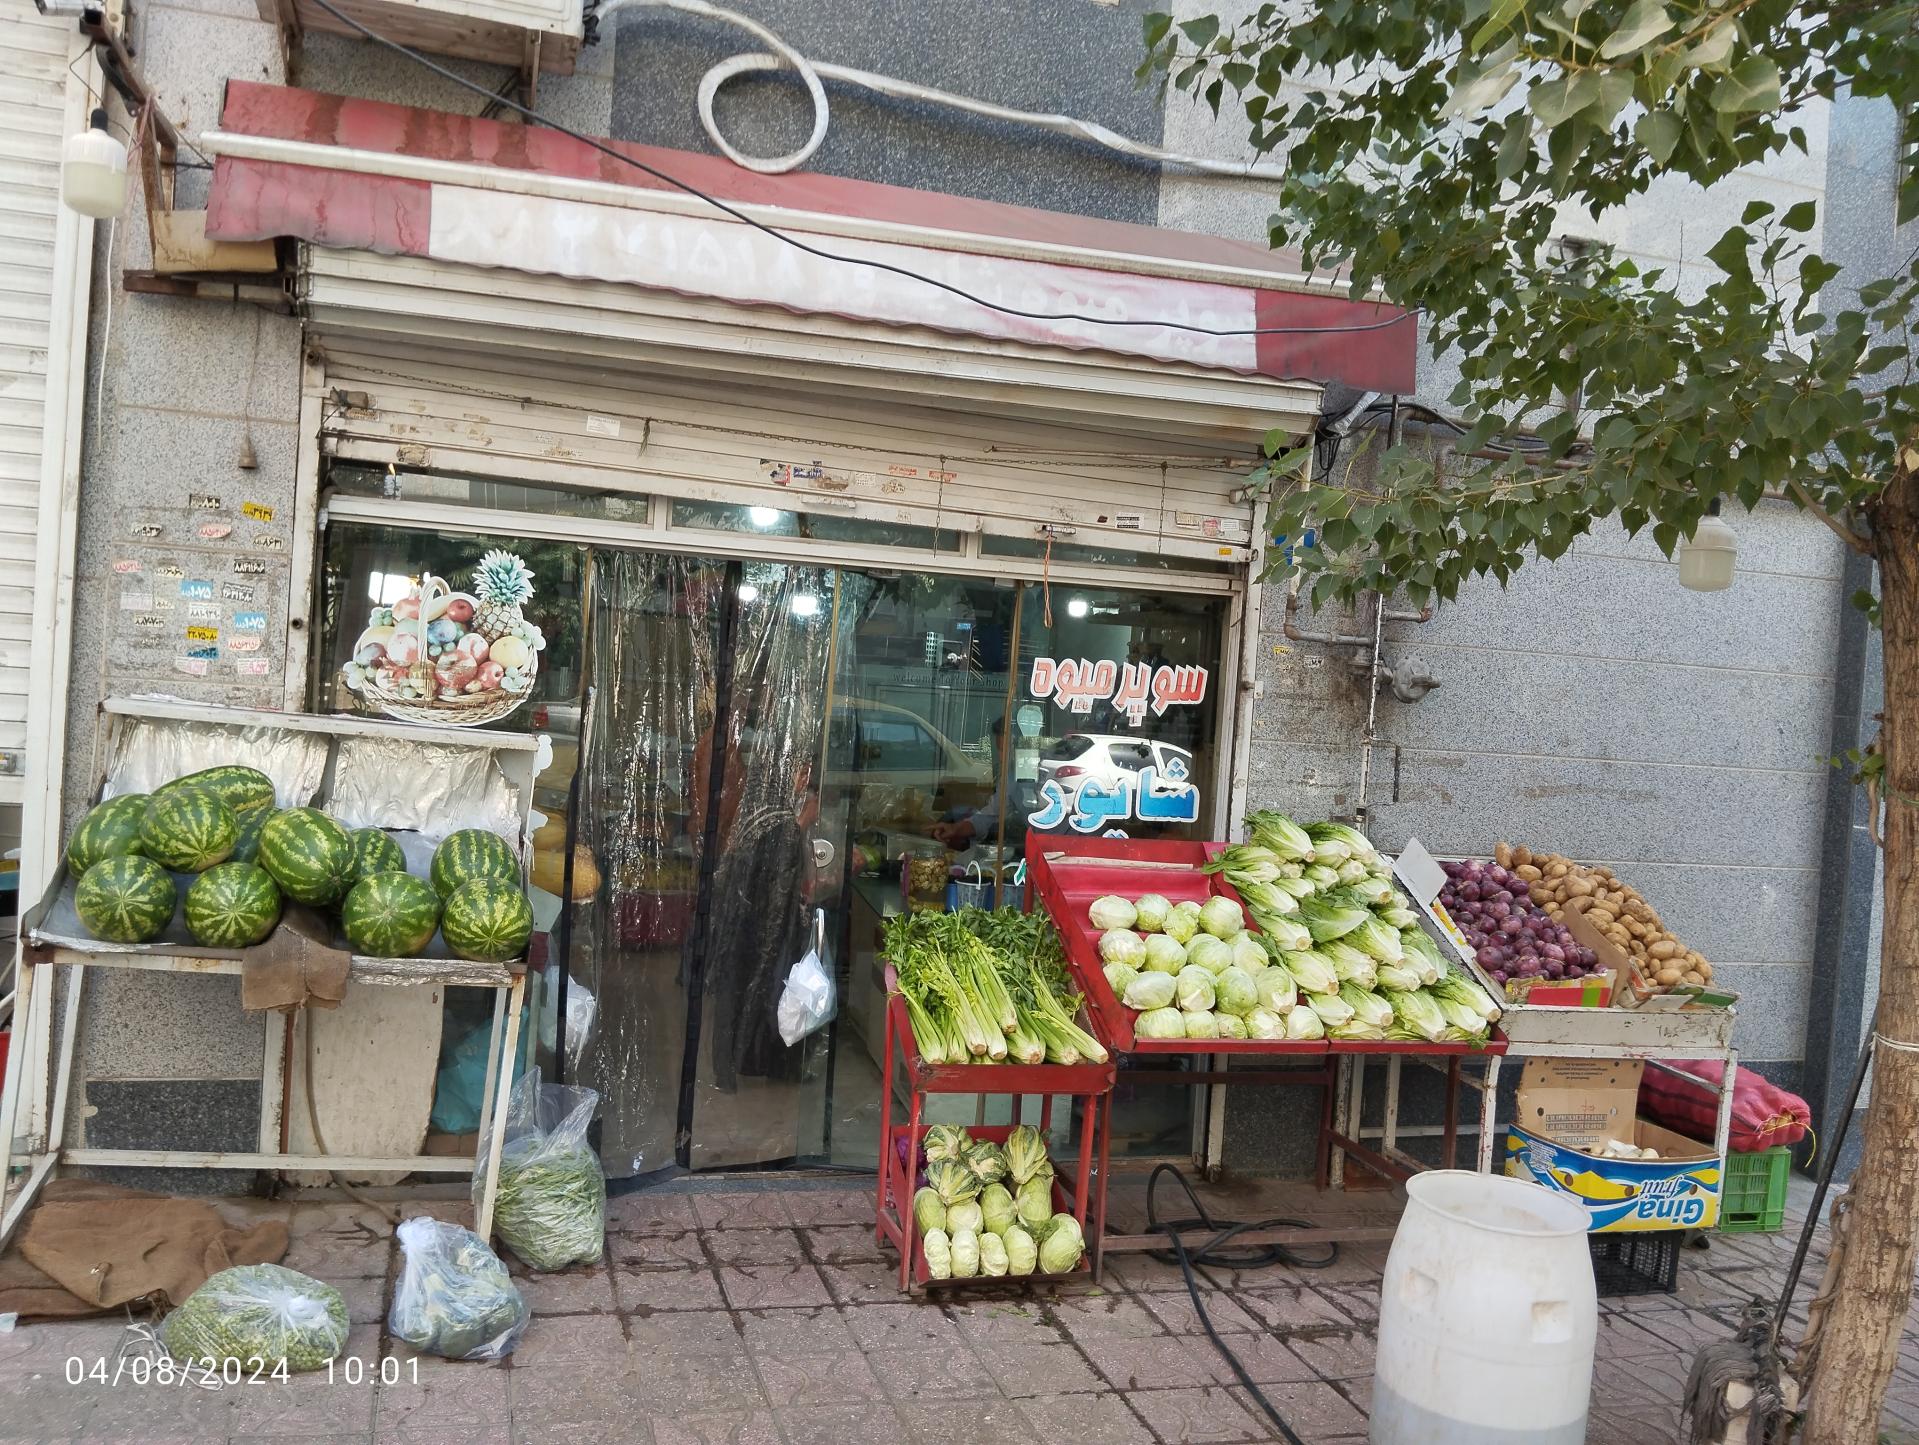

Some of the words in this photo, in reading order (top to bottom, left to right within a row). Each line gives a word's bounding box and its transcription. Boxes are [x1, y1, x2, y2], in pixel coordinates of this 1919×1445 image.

[1031, 657, 1117, 714] میوه
[1111, 662, 1208, 727] سوپر
[1028, 757, 1200, 839] شاپور
[1637, 1198, 1705, 1225] Gina
[1639, 1175, 1685, 1198] fruit
